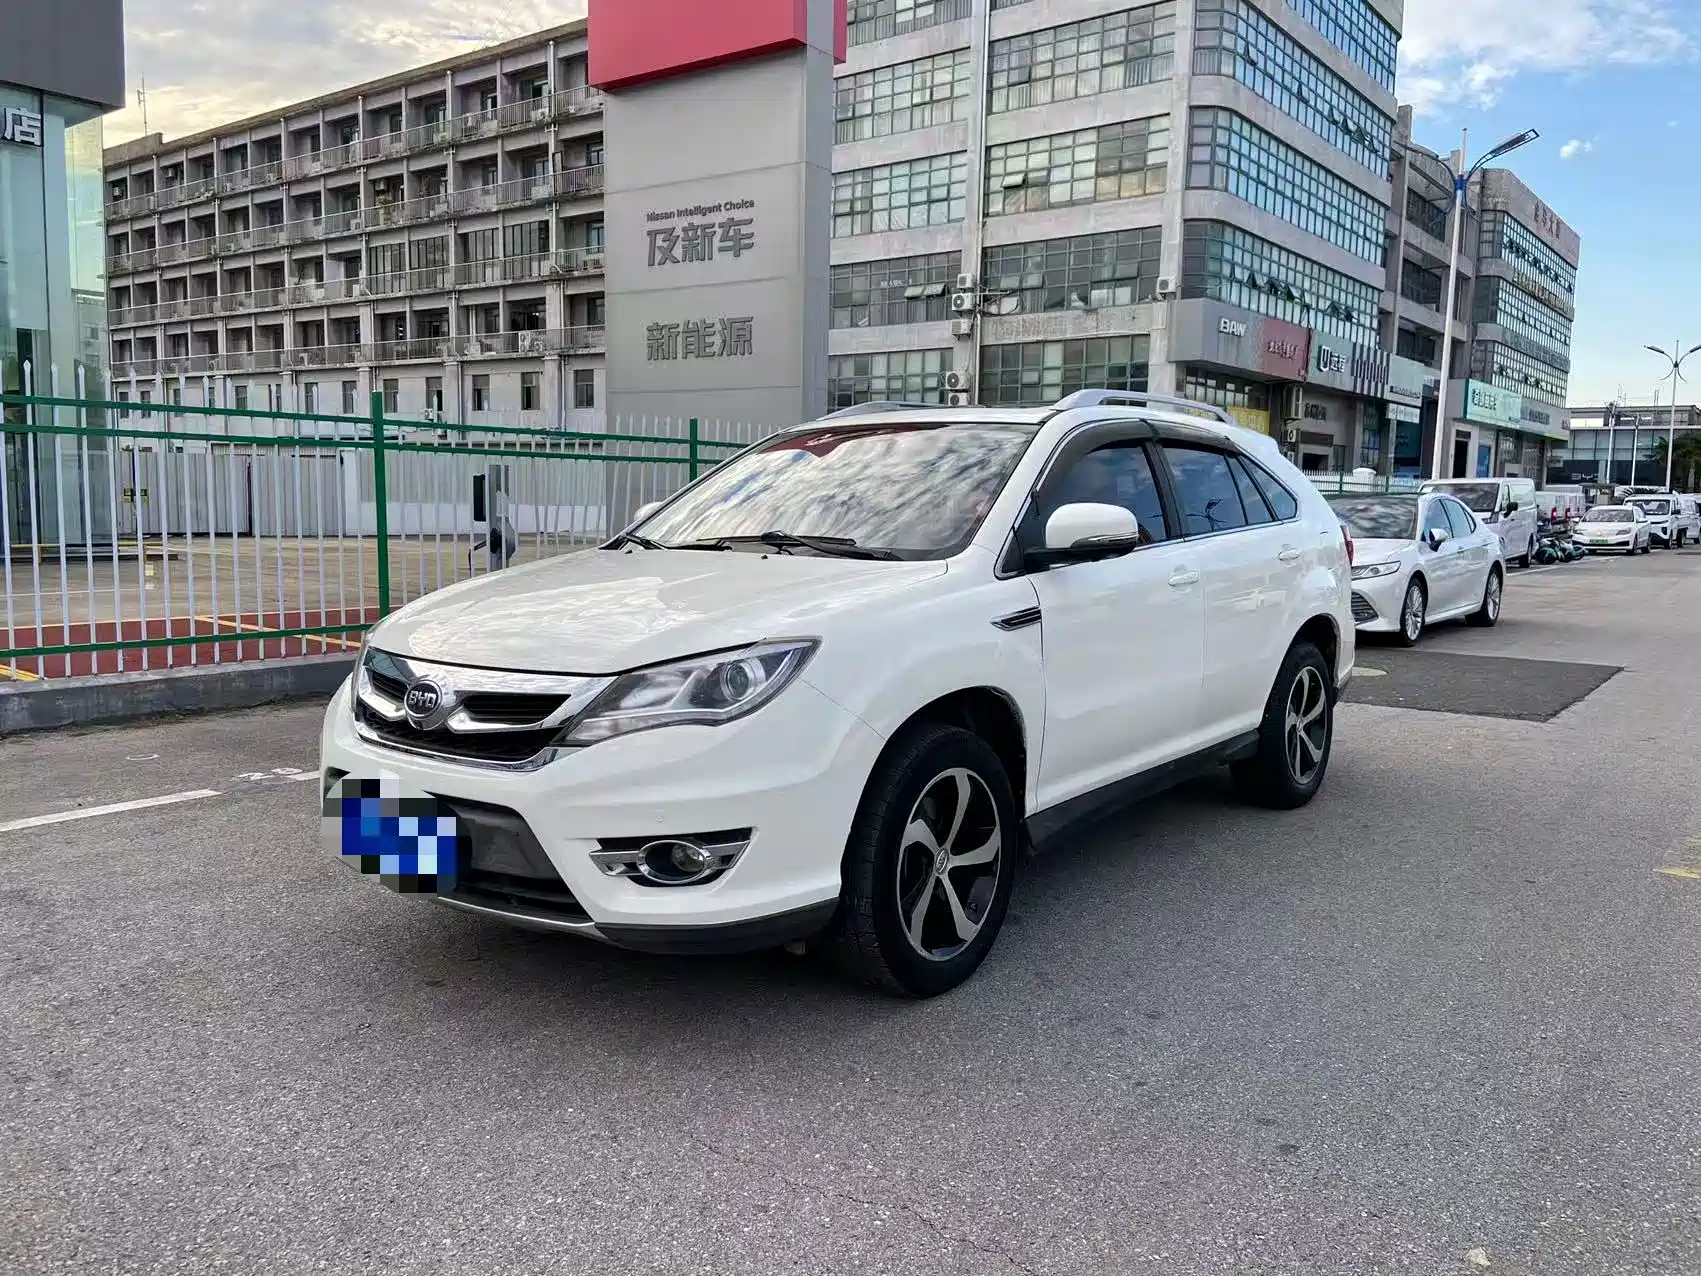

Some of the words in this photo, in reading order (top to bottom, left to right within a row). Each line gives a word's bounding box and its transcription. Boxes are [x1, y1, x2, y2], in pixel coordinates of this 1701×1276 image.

[4, 107, 41, 146] 店
[646, 210, 676, 223] Nissan
[677, 204, 722, 217] Intelligent
[724, 199, 755, 211] Choice
[646, 217, 755, 267] 及新车
[646, 316, 754, 361] 新能源
[1219, 317, 1247, 337] BAW
[408, 690, 437, 708] BYD
